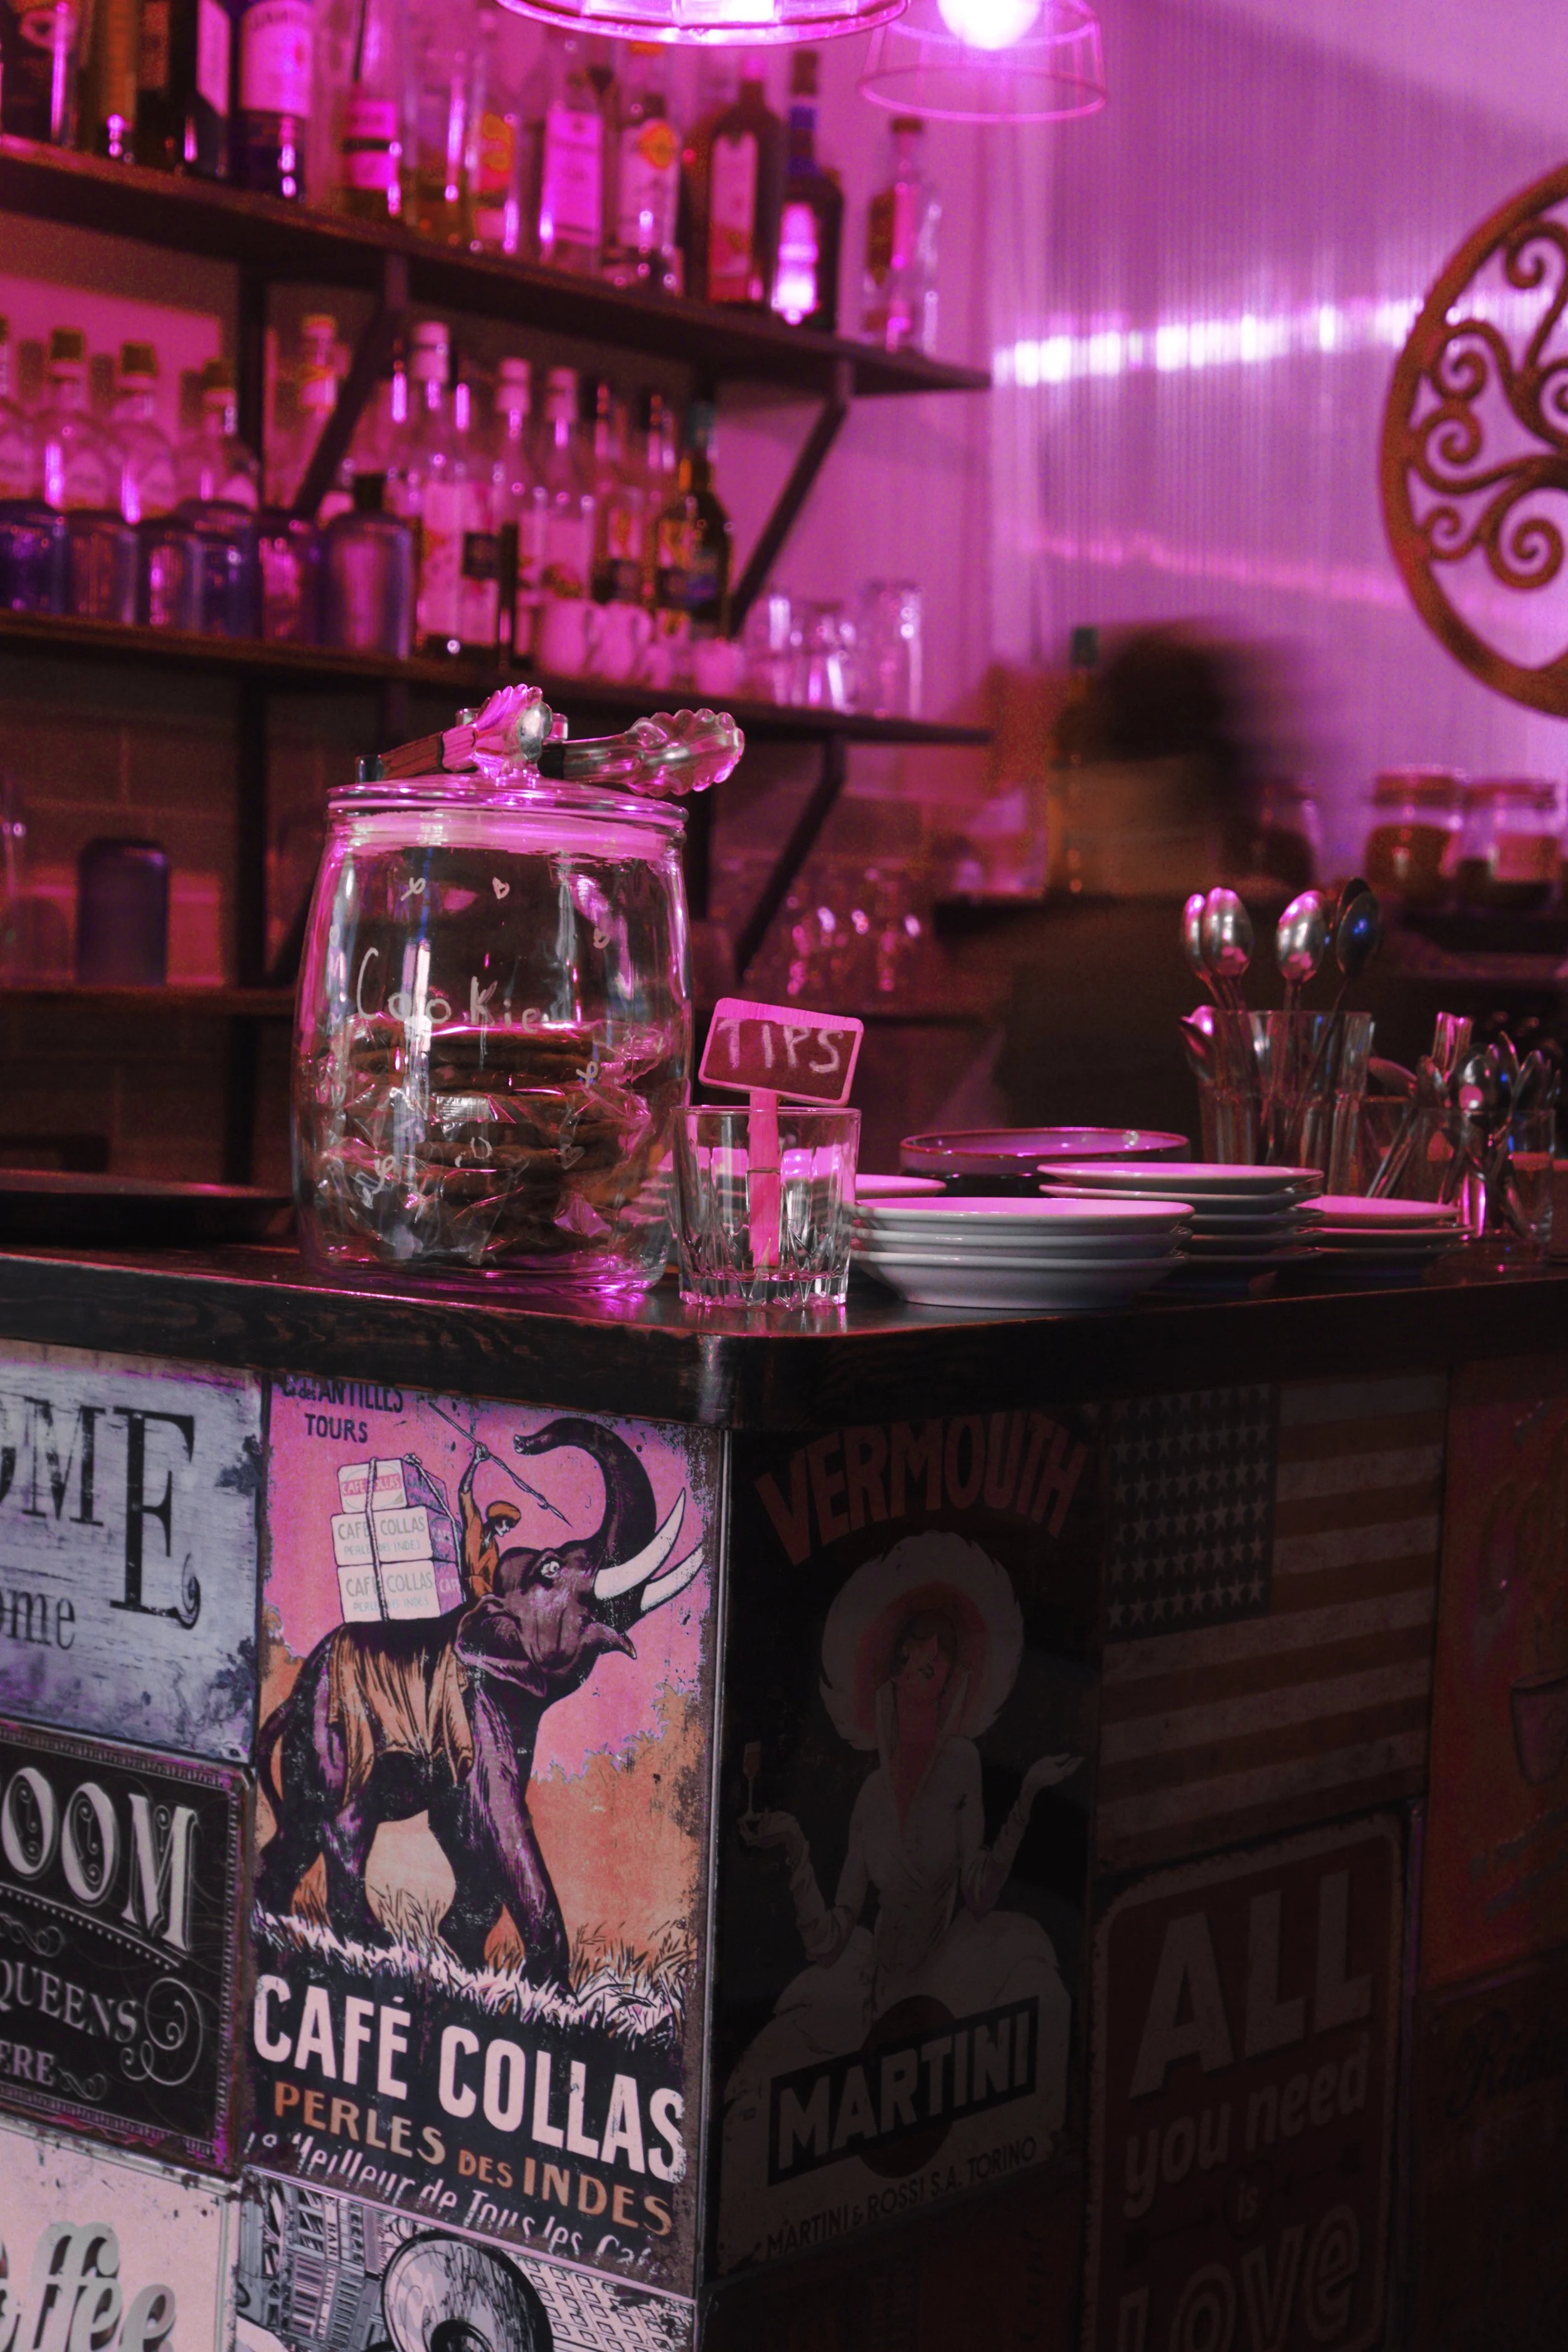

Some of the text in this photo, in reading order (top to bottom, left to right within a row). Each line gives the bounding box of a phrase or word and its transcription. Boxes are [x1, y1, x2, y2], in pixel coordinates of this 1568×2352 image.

[717, 1018, 844, 1074] TIPS
[304, 1412, 368, 1443] TOURS
[755, 1409, 1089, 1567] VERMOUTH
[0, 1394, 201, 1630] ME
[380, 1516, 426, 1536] COLLAS
[0, 1589, 75, 1650] me
[386, 1572, 433, 1593] COLLAS
[1129, 1870, 1372, 2099] ALL
[253, 1974, 686, 2184] CAFÉ COLLAS
[777, 2011, 1030, 2170] MARTINI
[1123, 2102, 1232, 2219] you
[1245, 2031, 1370, 2152] need
[274, 2081, 673, 2237] PERLES DES INDES
[767, 2204, 849, 2259] MARTINI
[852, 2205, 864, 2227] &
[867, 2176, 925, 2223] ROSSI
[968, 2136, 1037, 2183] TORINO
[1237, 2181, 1259, 2223] is
[0, 2222, 177, 2352] ffee
